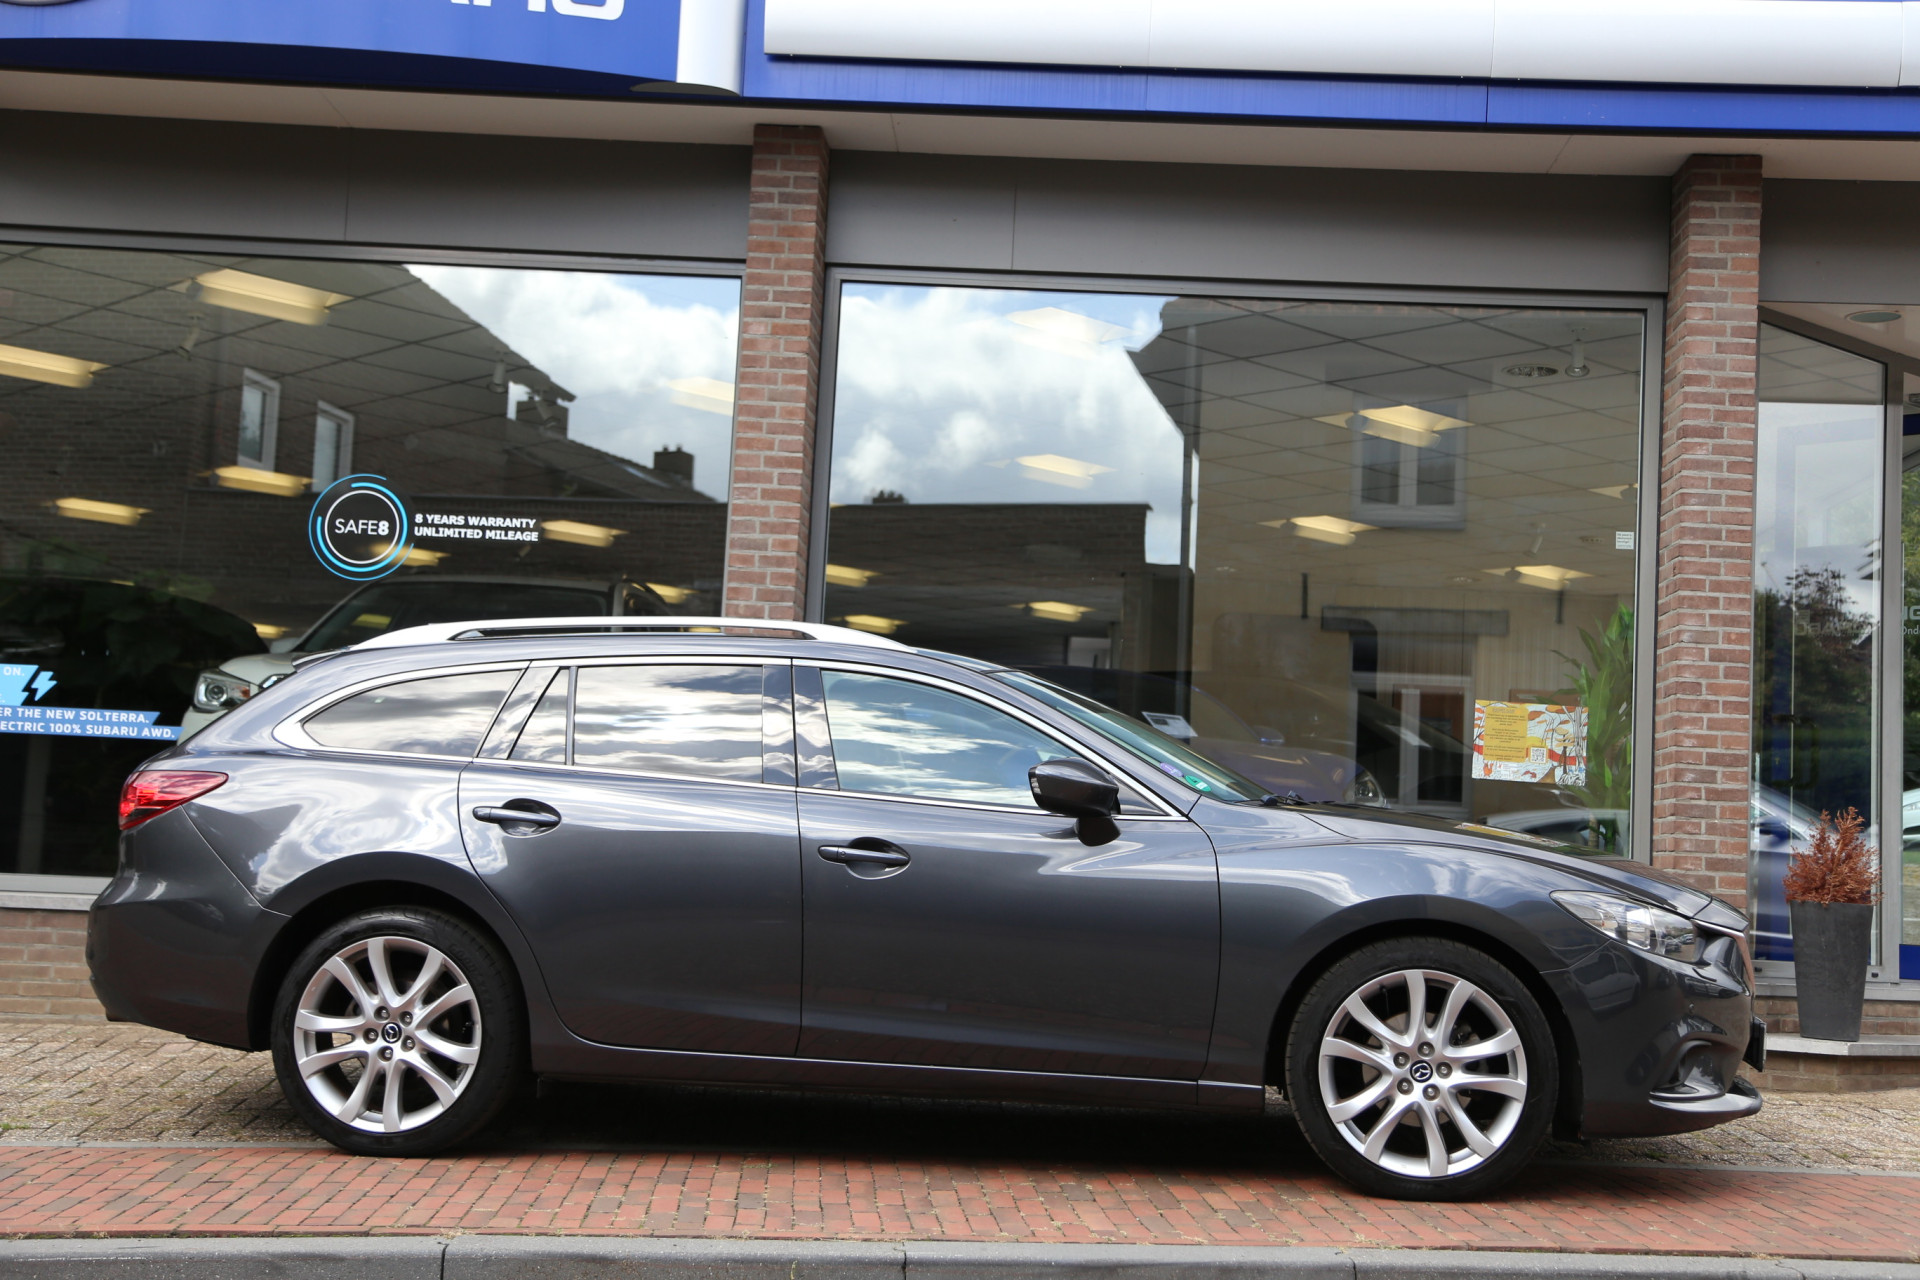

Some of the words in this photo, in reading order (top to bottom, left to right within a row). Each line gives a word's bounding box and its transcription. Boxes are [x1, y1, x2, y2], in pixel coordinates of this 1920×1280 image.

[334, 518, 390, 536] SAFE8
[415, 513, 424, 524] 8
[426, 514, 466, 525] YEARS
[468, 516, 537, 529] WARRANTY
[414, 526, 483, 539] UNLIMITED
[485, 529, 539, 542] MILEAGE
[3, 666, 25, 676] ON.
[16, 707, 42, 718] THE
[46, 709, 76, 720] NEW
[79, 710, 150, 724] SOLTERRA.
[49, 723, 82, 734] 100%
[86, 724, 138, 737] SUBARU
[141, 727, 175, 739] AWD.
